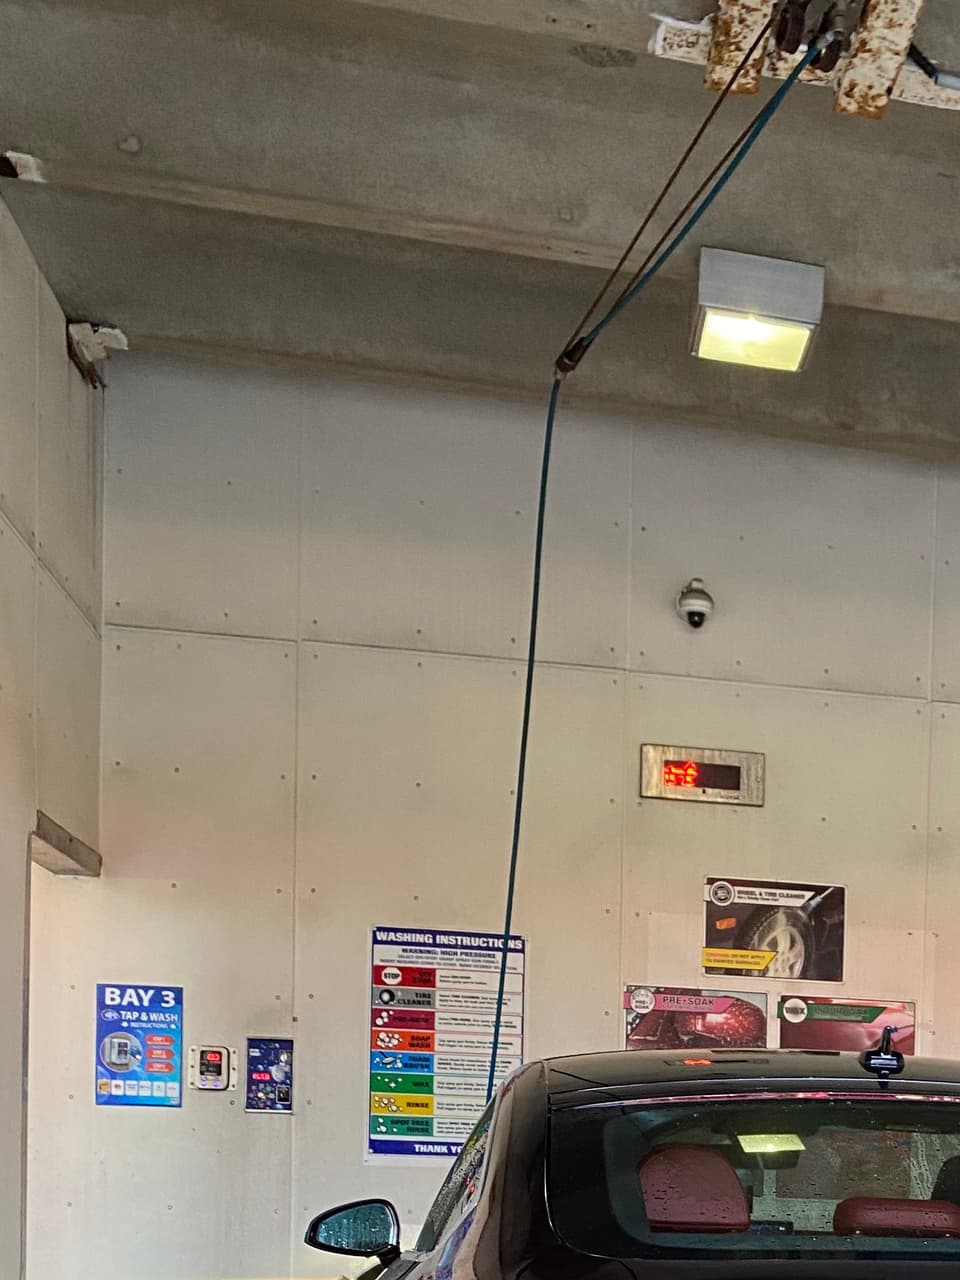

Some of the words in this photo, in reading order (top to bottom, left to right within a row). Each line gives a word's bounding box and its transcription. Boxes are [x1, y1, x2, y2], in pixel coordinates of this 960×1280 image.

[376, 931, 433, 944] WASHING
[383, 972, 400, 980] STOP
[104, 987, 155, 1006] BAY
[161, 990, 176, 1008] 3
[120, 1010, 139, 1020] TAP
[140, 1012, 149, 1020] &
[150, 1012, 178, 1022] WASH
[414, 1144, 449, 1153] THANK
